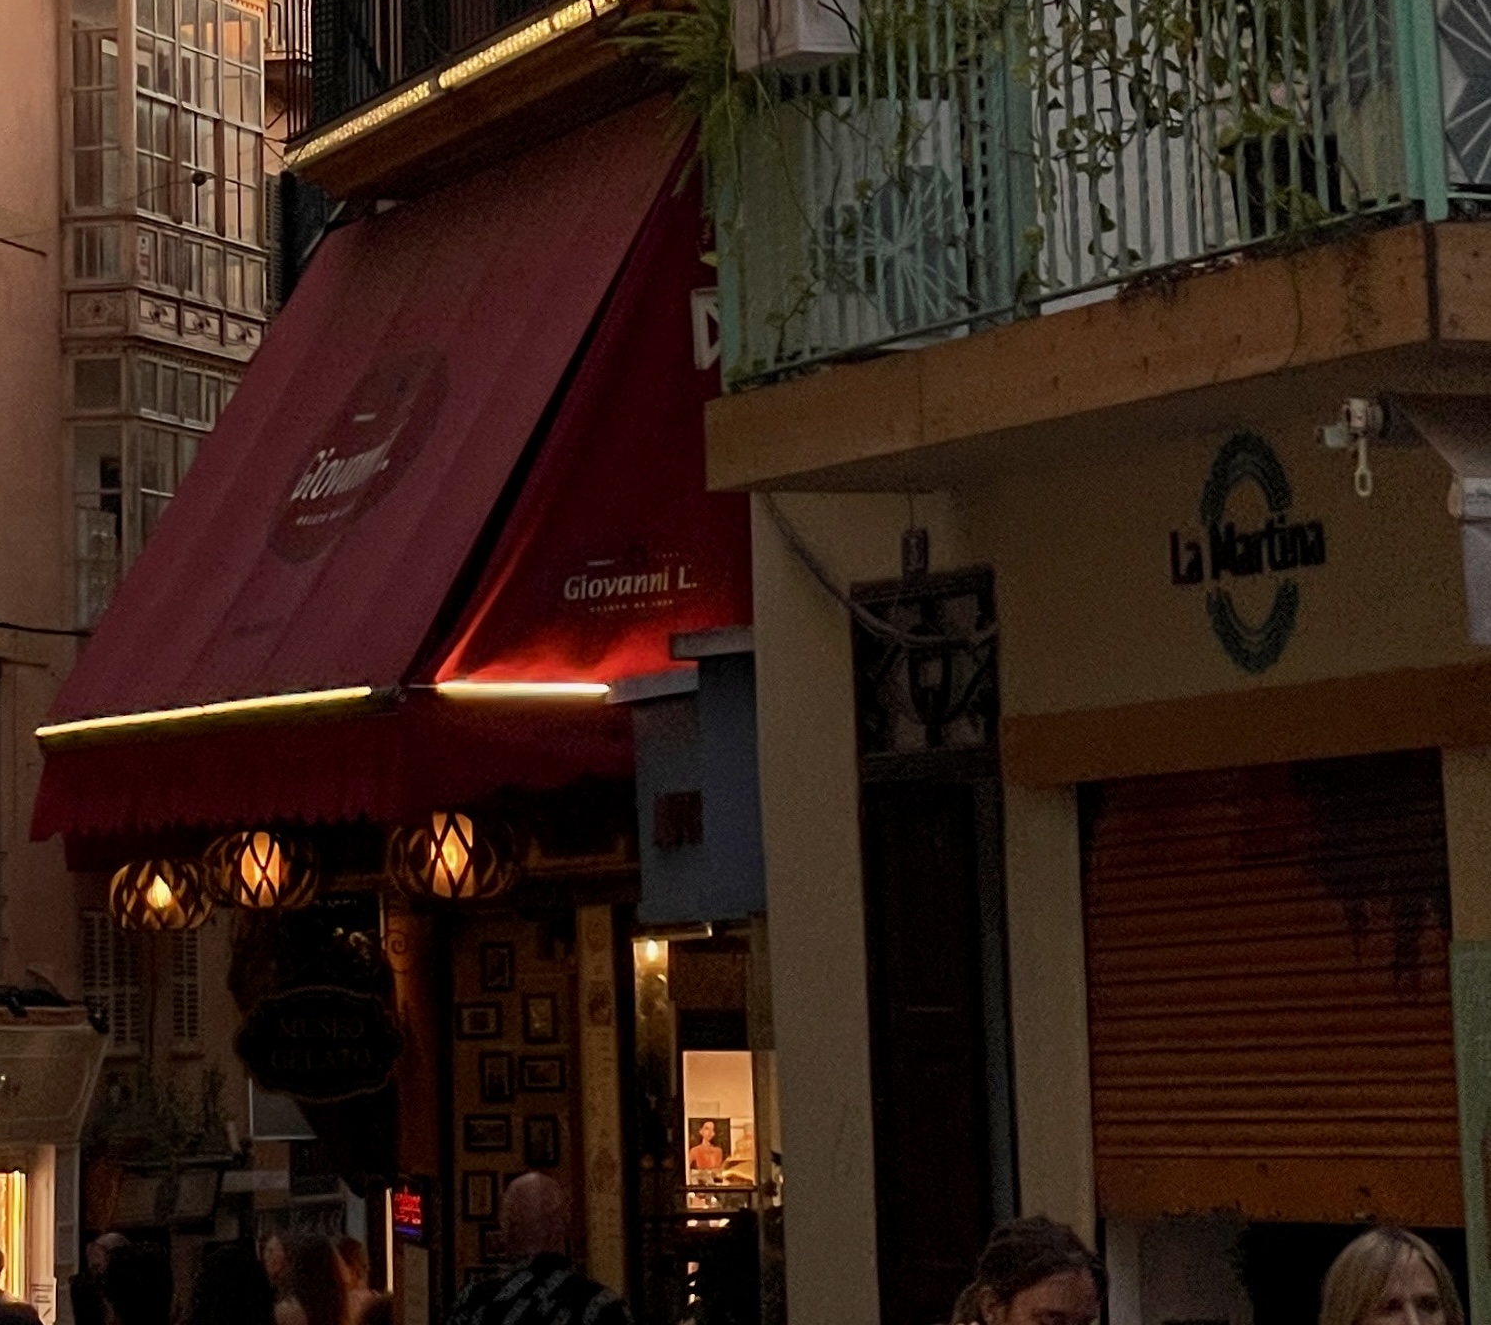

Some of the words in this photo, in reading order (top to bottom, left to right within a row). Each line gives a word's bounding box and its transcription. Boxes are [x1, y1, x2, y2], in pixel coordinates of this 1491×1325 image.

[1170, 531, 1204, 585] La
[1208, 514, 1326, 579] Martina
[563, 565, 671, 601] Giovanni
[677, 564, 699, 591] L.
